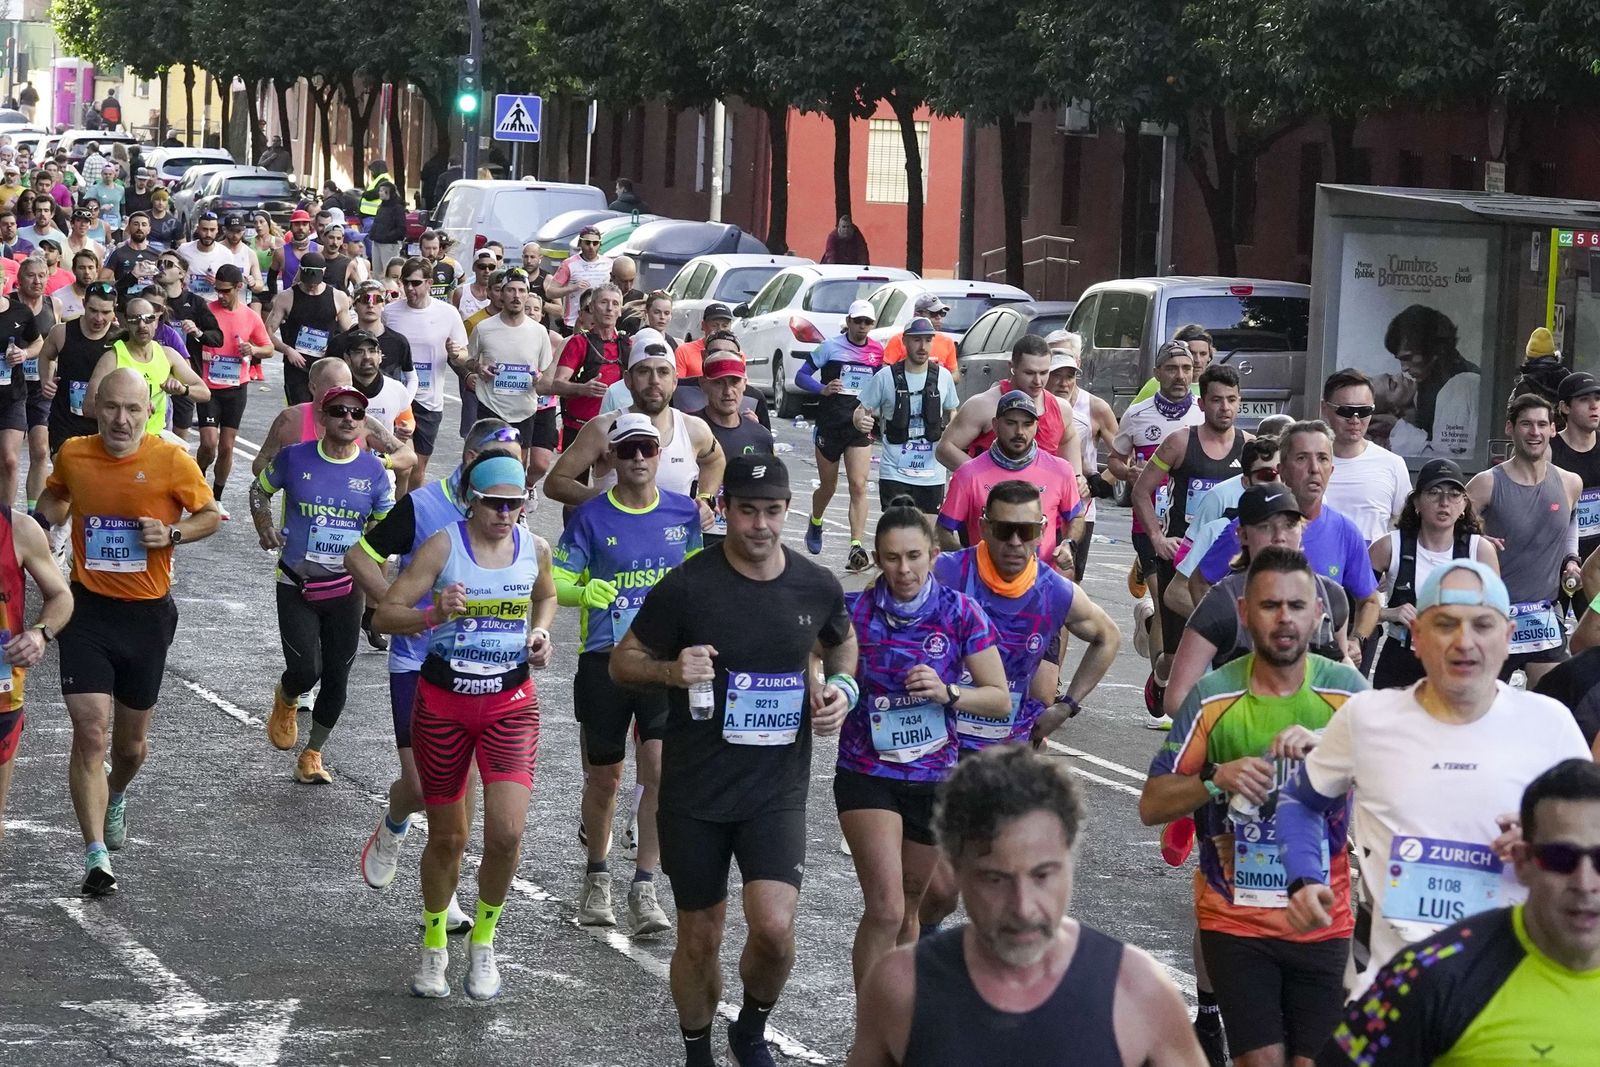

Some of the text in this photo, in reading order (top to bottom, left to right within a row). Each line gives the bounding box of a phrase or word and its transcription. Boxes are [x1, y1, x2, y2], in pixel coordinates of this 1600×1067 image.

[1559, 233, 1599, 244] C2 5 6
[852, 366, 873, 374] ZURICH
[495, 379, 528, 389] GREGOUZE
[1253, 403, 1273, 413] KNT
[1578, 491, 1600, 502] URICH
[105, 519, 140, 528] ZURICH
[330, 518, 357, 528] ZURICH
[1578, 513, 1599, 526] OLÁS
[105, 536, 125, 544] 9160
[329, 533, 344, 541] 7627
[100, 547, 130, 559] FRED
[614, 567, 673, 589] TUSSA
[465, 587, 492, 597] Digital
[463, 601, 527, 618] iningRey
[480, 620, 517, 630] ZURICH
[1512, 627, 1556, 641] JESUSGD
[480, 638, 501, 648] 5972
[756, 676, 798, 688] ZURICH
[755, 699, 779, 709] 9213
[895, 695, 931, 708] ZURIC
[725, 711, 800, 728] A. FIANCES
[899, 714, 923, 727] 7434
[891, 726, 933, 747] FURIA
[1443, 762, 1479, 771] TERREX
[1429, 845, 1492, 866] ZURICH
[1428, 876, 1462, 893] 8108
[1418, 896, 1465, 920] LUIS
